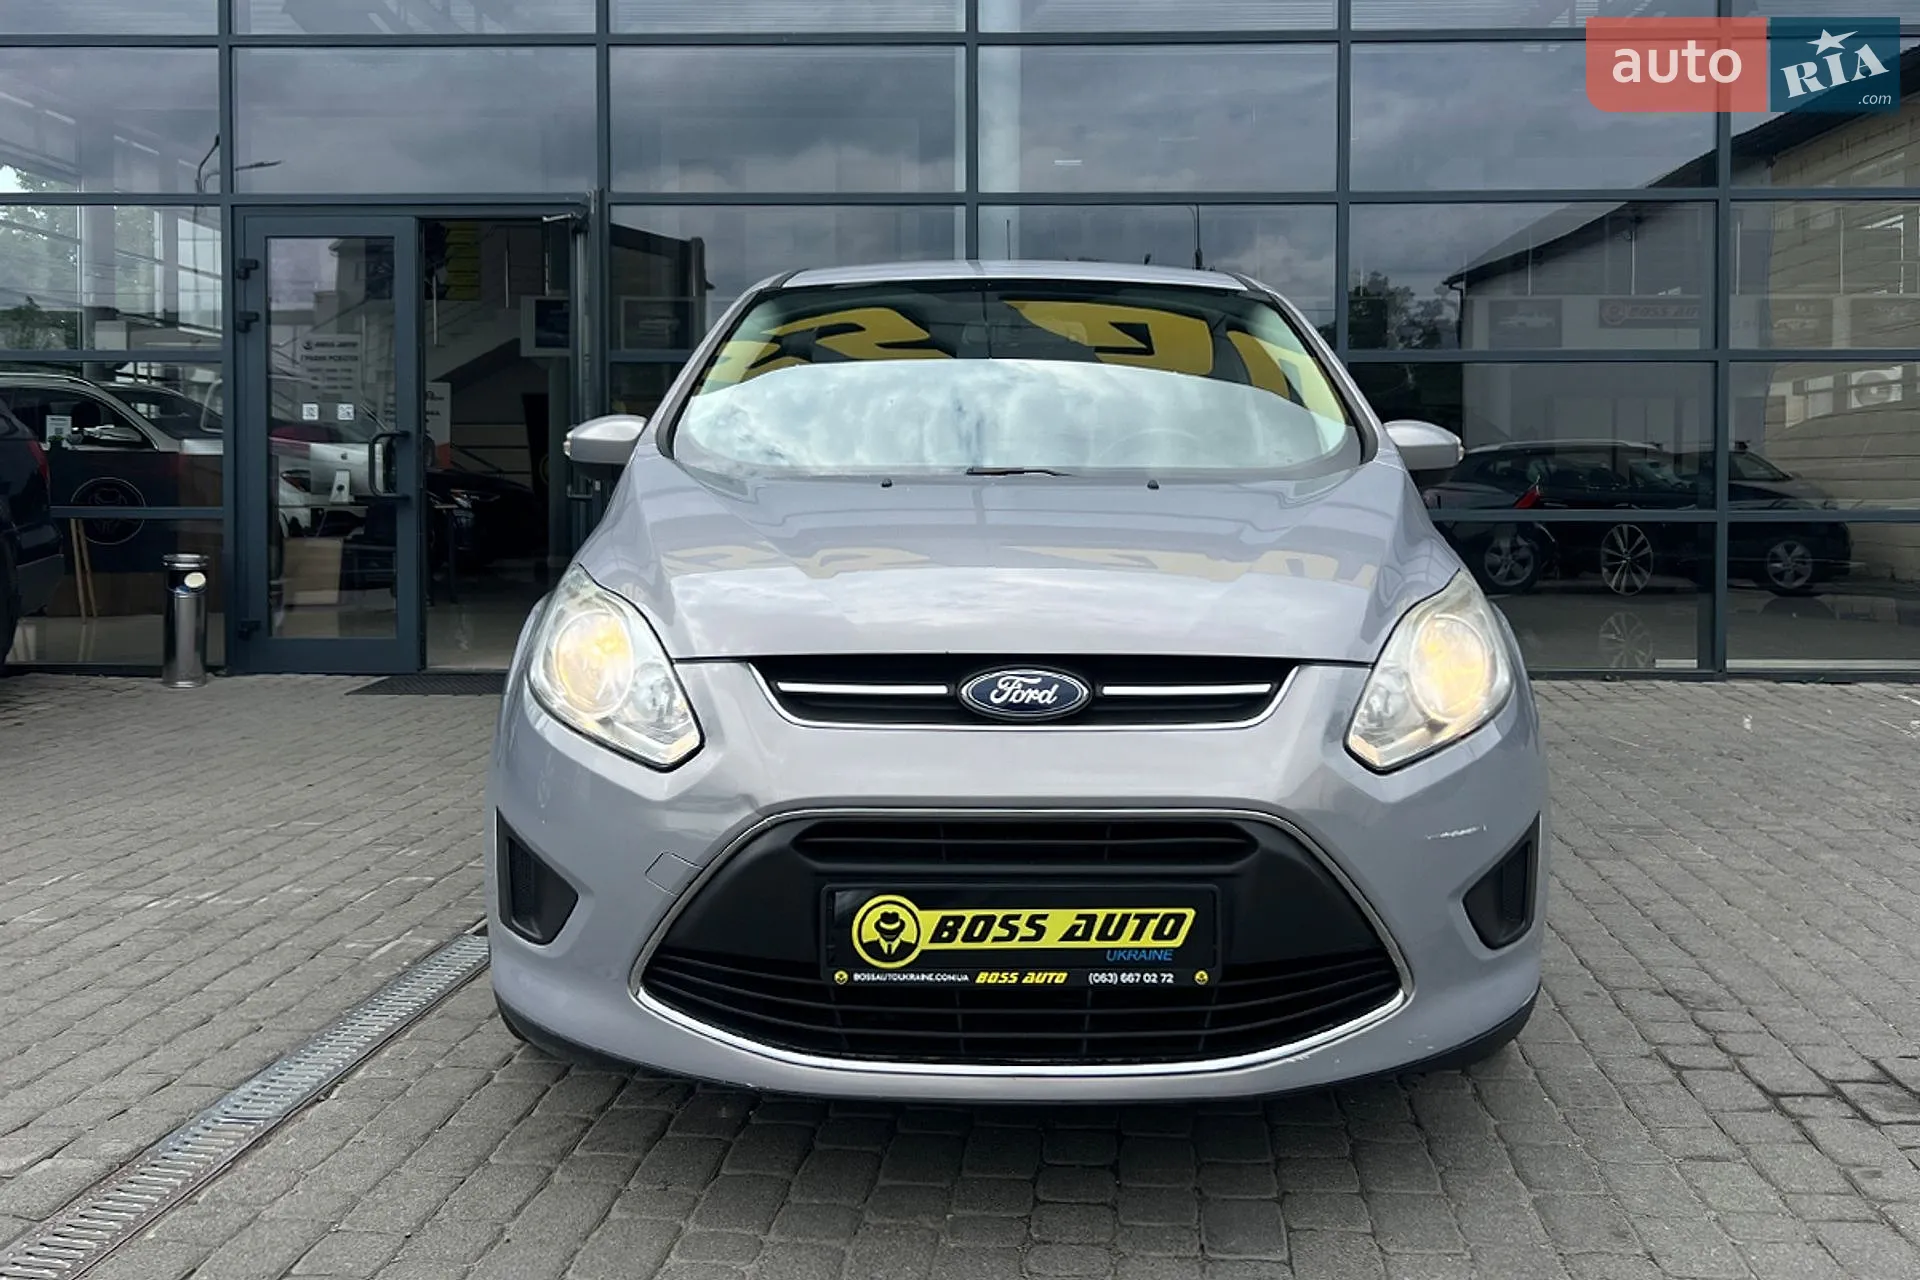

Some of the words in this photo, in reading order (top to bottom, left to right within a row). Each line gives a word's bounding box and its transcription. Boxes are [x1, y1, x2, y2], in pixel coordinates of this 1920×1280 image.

[990, 676, 1059, 704] Ford
[928, 913, 1048, 943] BOSS
[1058, 913, 1187, 943] AUTO
[1106, 949, 1173, 961] UKRAINE
[975, 972, 1019, 984] BOSS
[1022, 972, 1068, 984] AUTO
[1143, 973, 1158, 983] 02
[1160, 973, 1174, 983] 72
